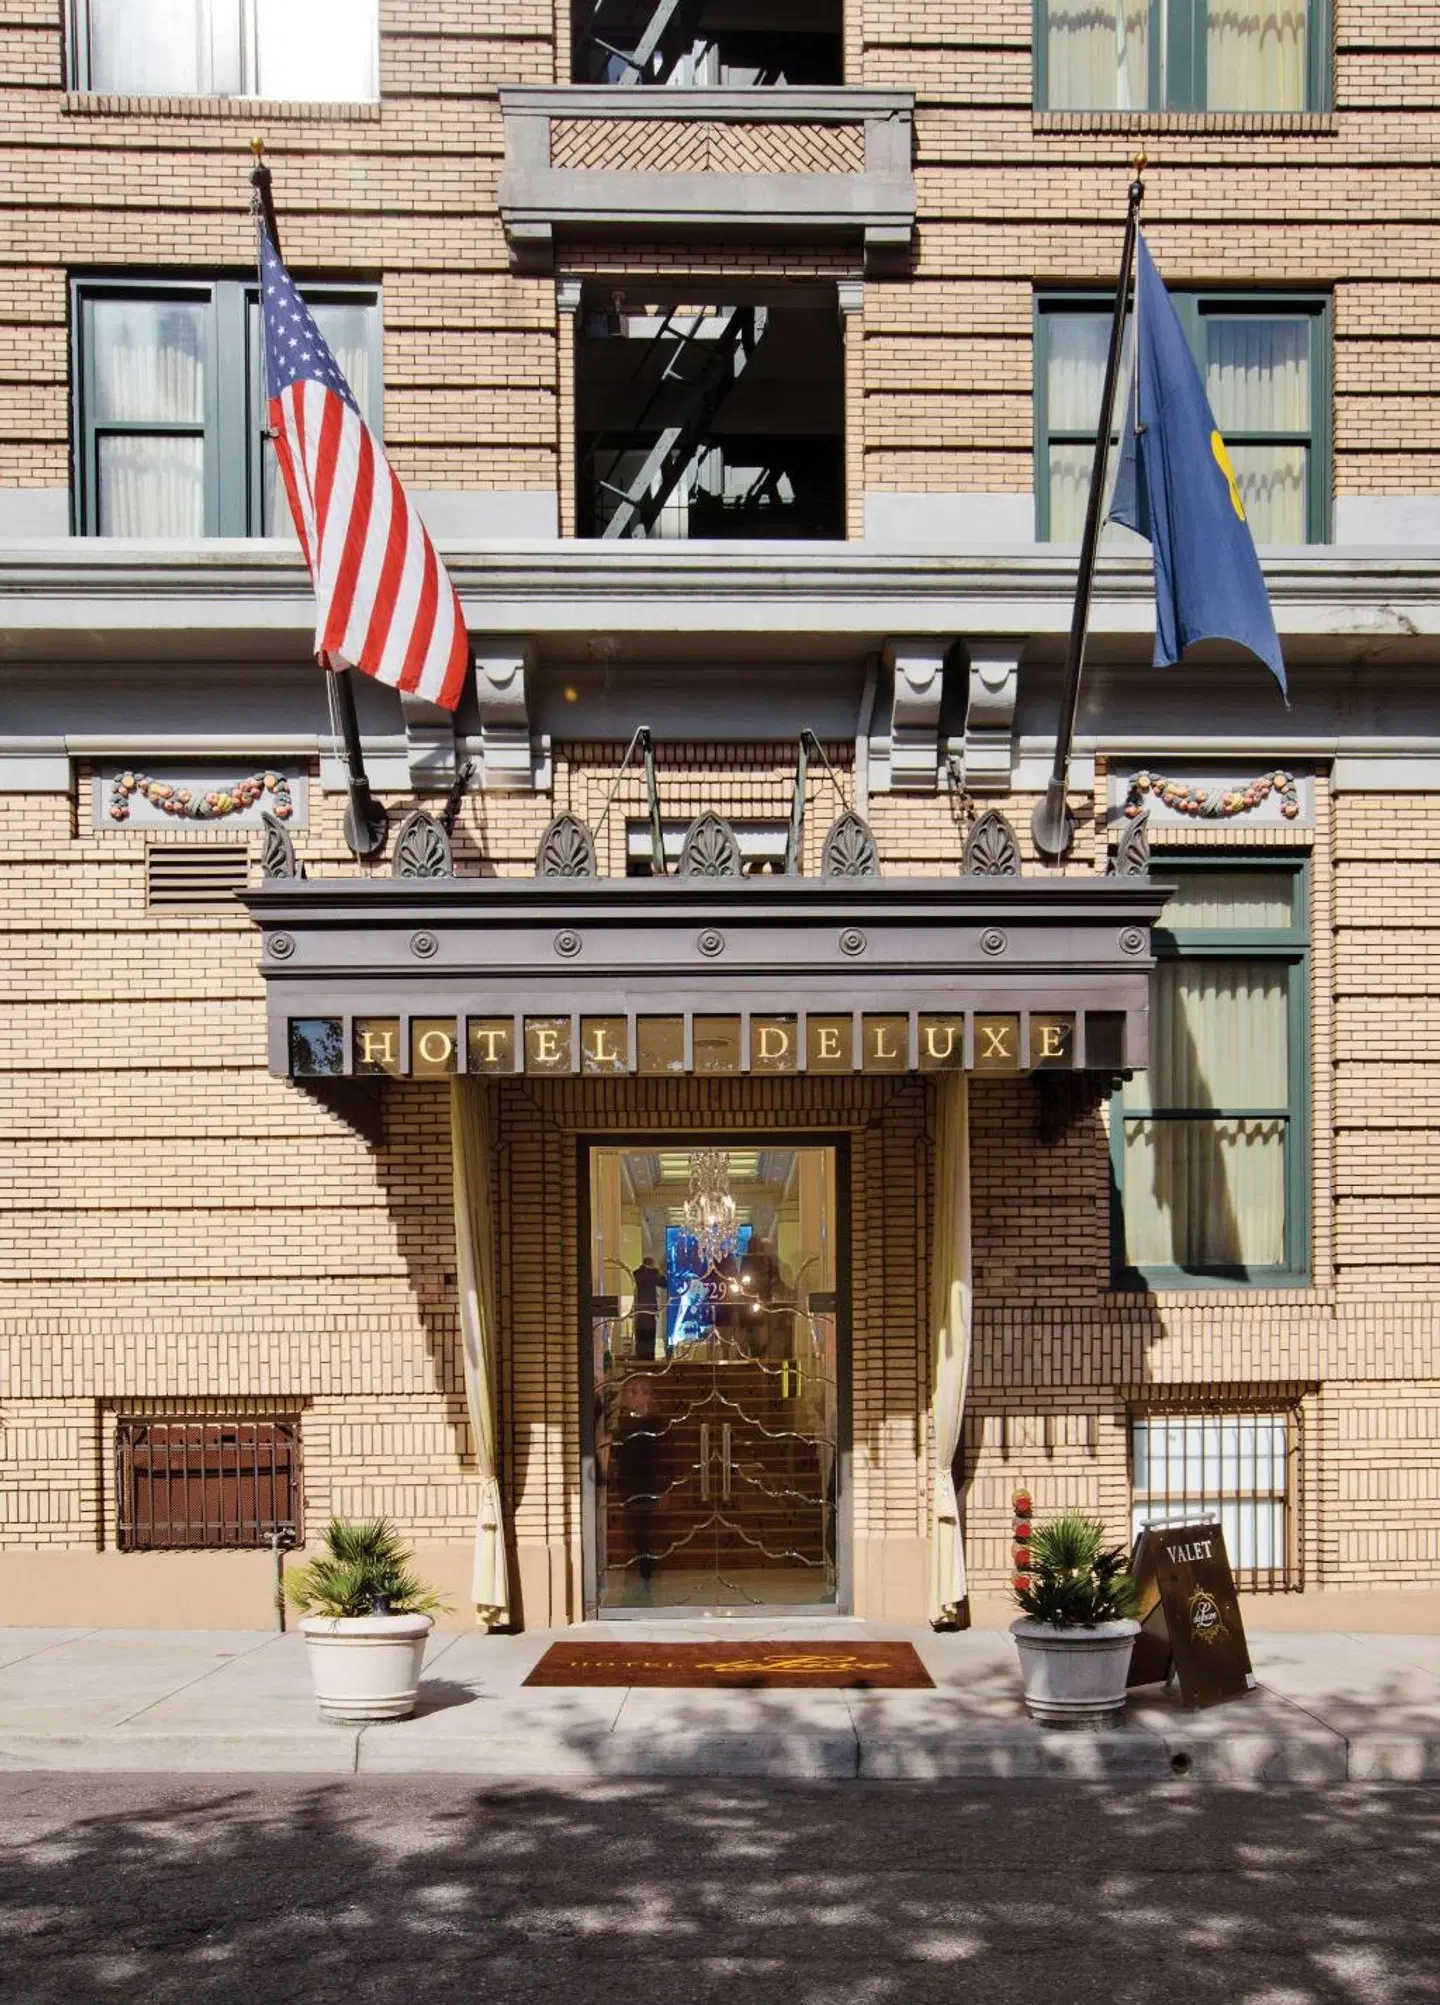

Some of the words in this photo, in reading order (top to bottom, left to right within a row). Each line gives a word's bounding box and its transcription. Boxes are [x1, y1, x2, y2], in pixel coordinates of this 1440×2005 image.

[362, 1029, 618, 1064] HOTEL
[757, 1026, 1066, 1060] DELUXE
[1165, 1539, 1213, 1564] VALET
